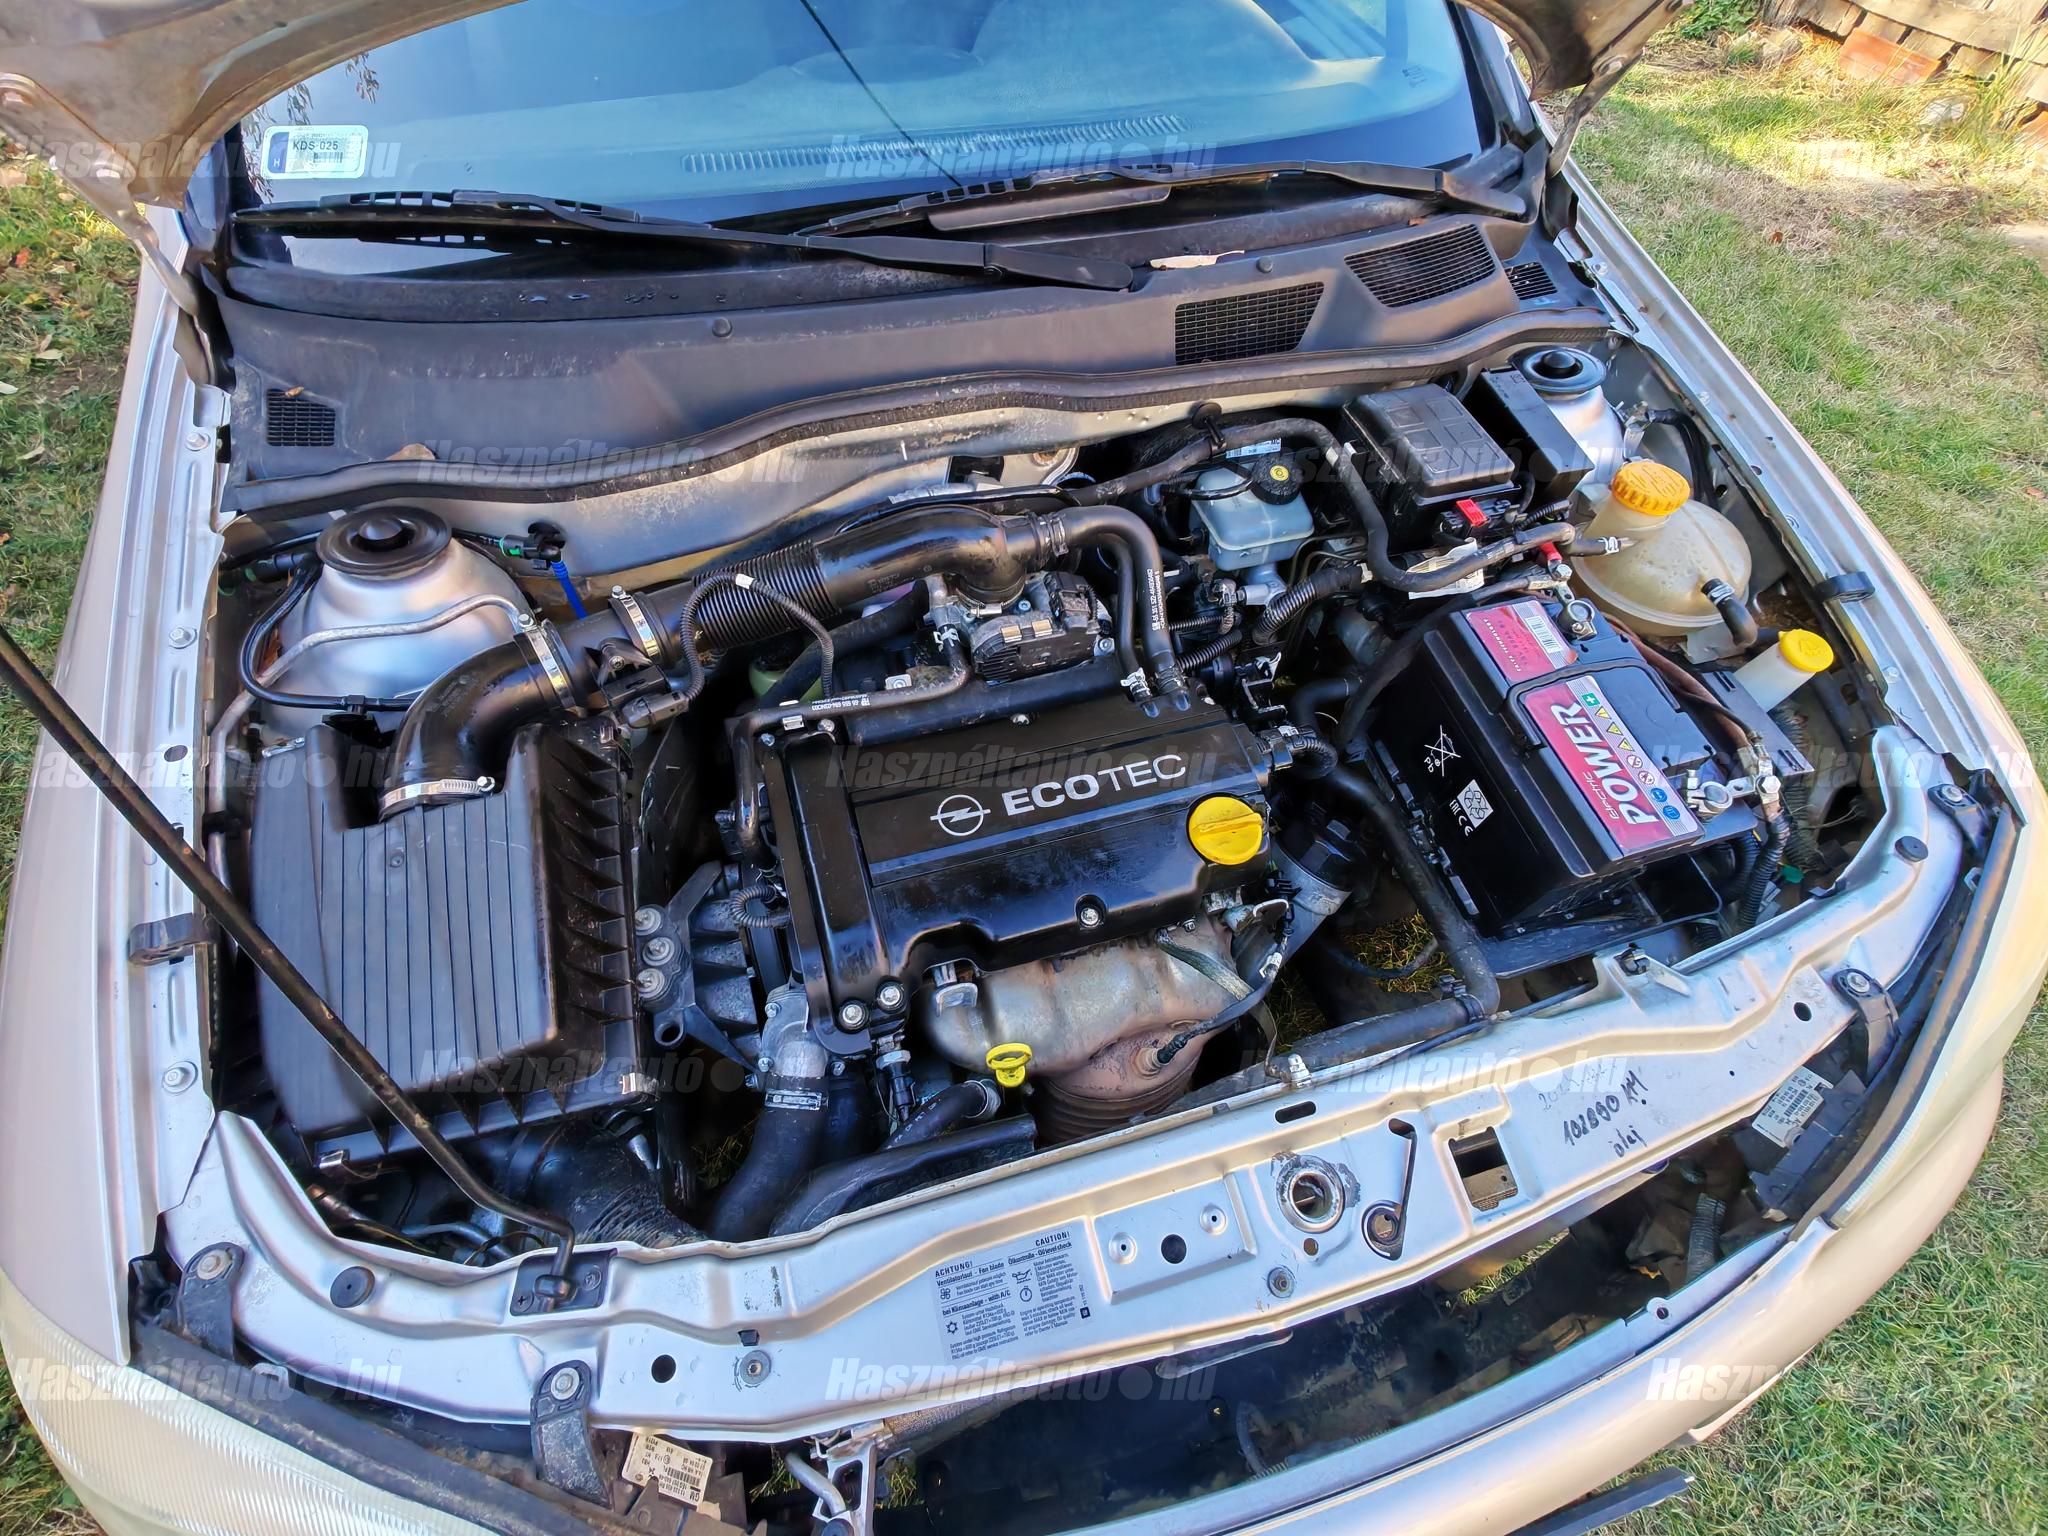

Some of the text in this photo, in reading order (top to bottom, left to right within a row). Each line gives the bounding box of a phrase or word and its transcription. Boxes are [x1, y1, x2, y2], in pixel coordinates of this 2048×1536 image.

[1550, 702, 1660, 825] POWER
[1001, 754, 1186, 817] ECOTEC
[1035, 1231, 1070, 1247] CAUTION!
[935, 1260, 973, 1278] ACHTUNG!
[689, 1490, 700, 1501] GM
